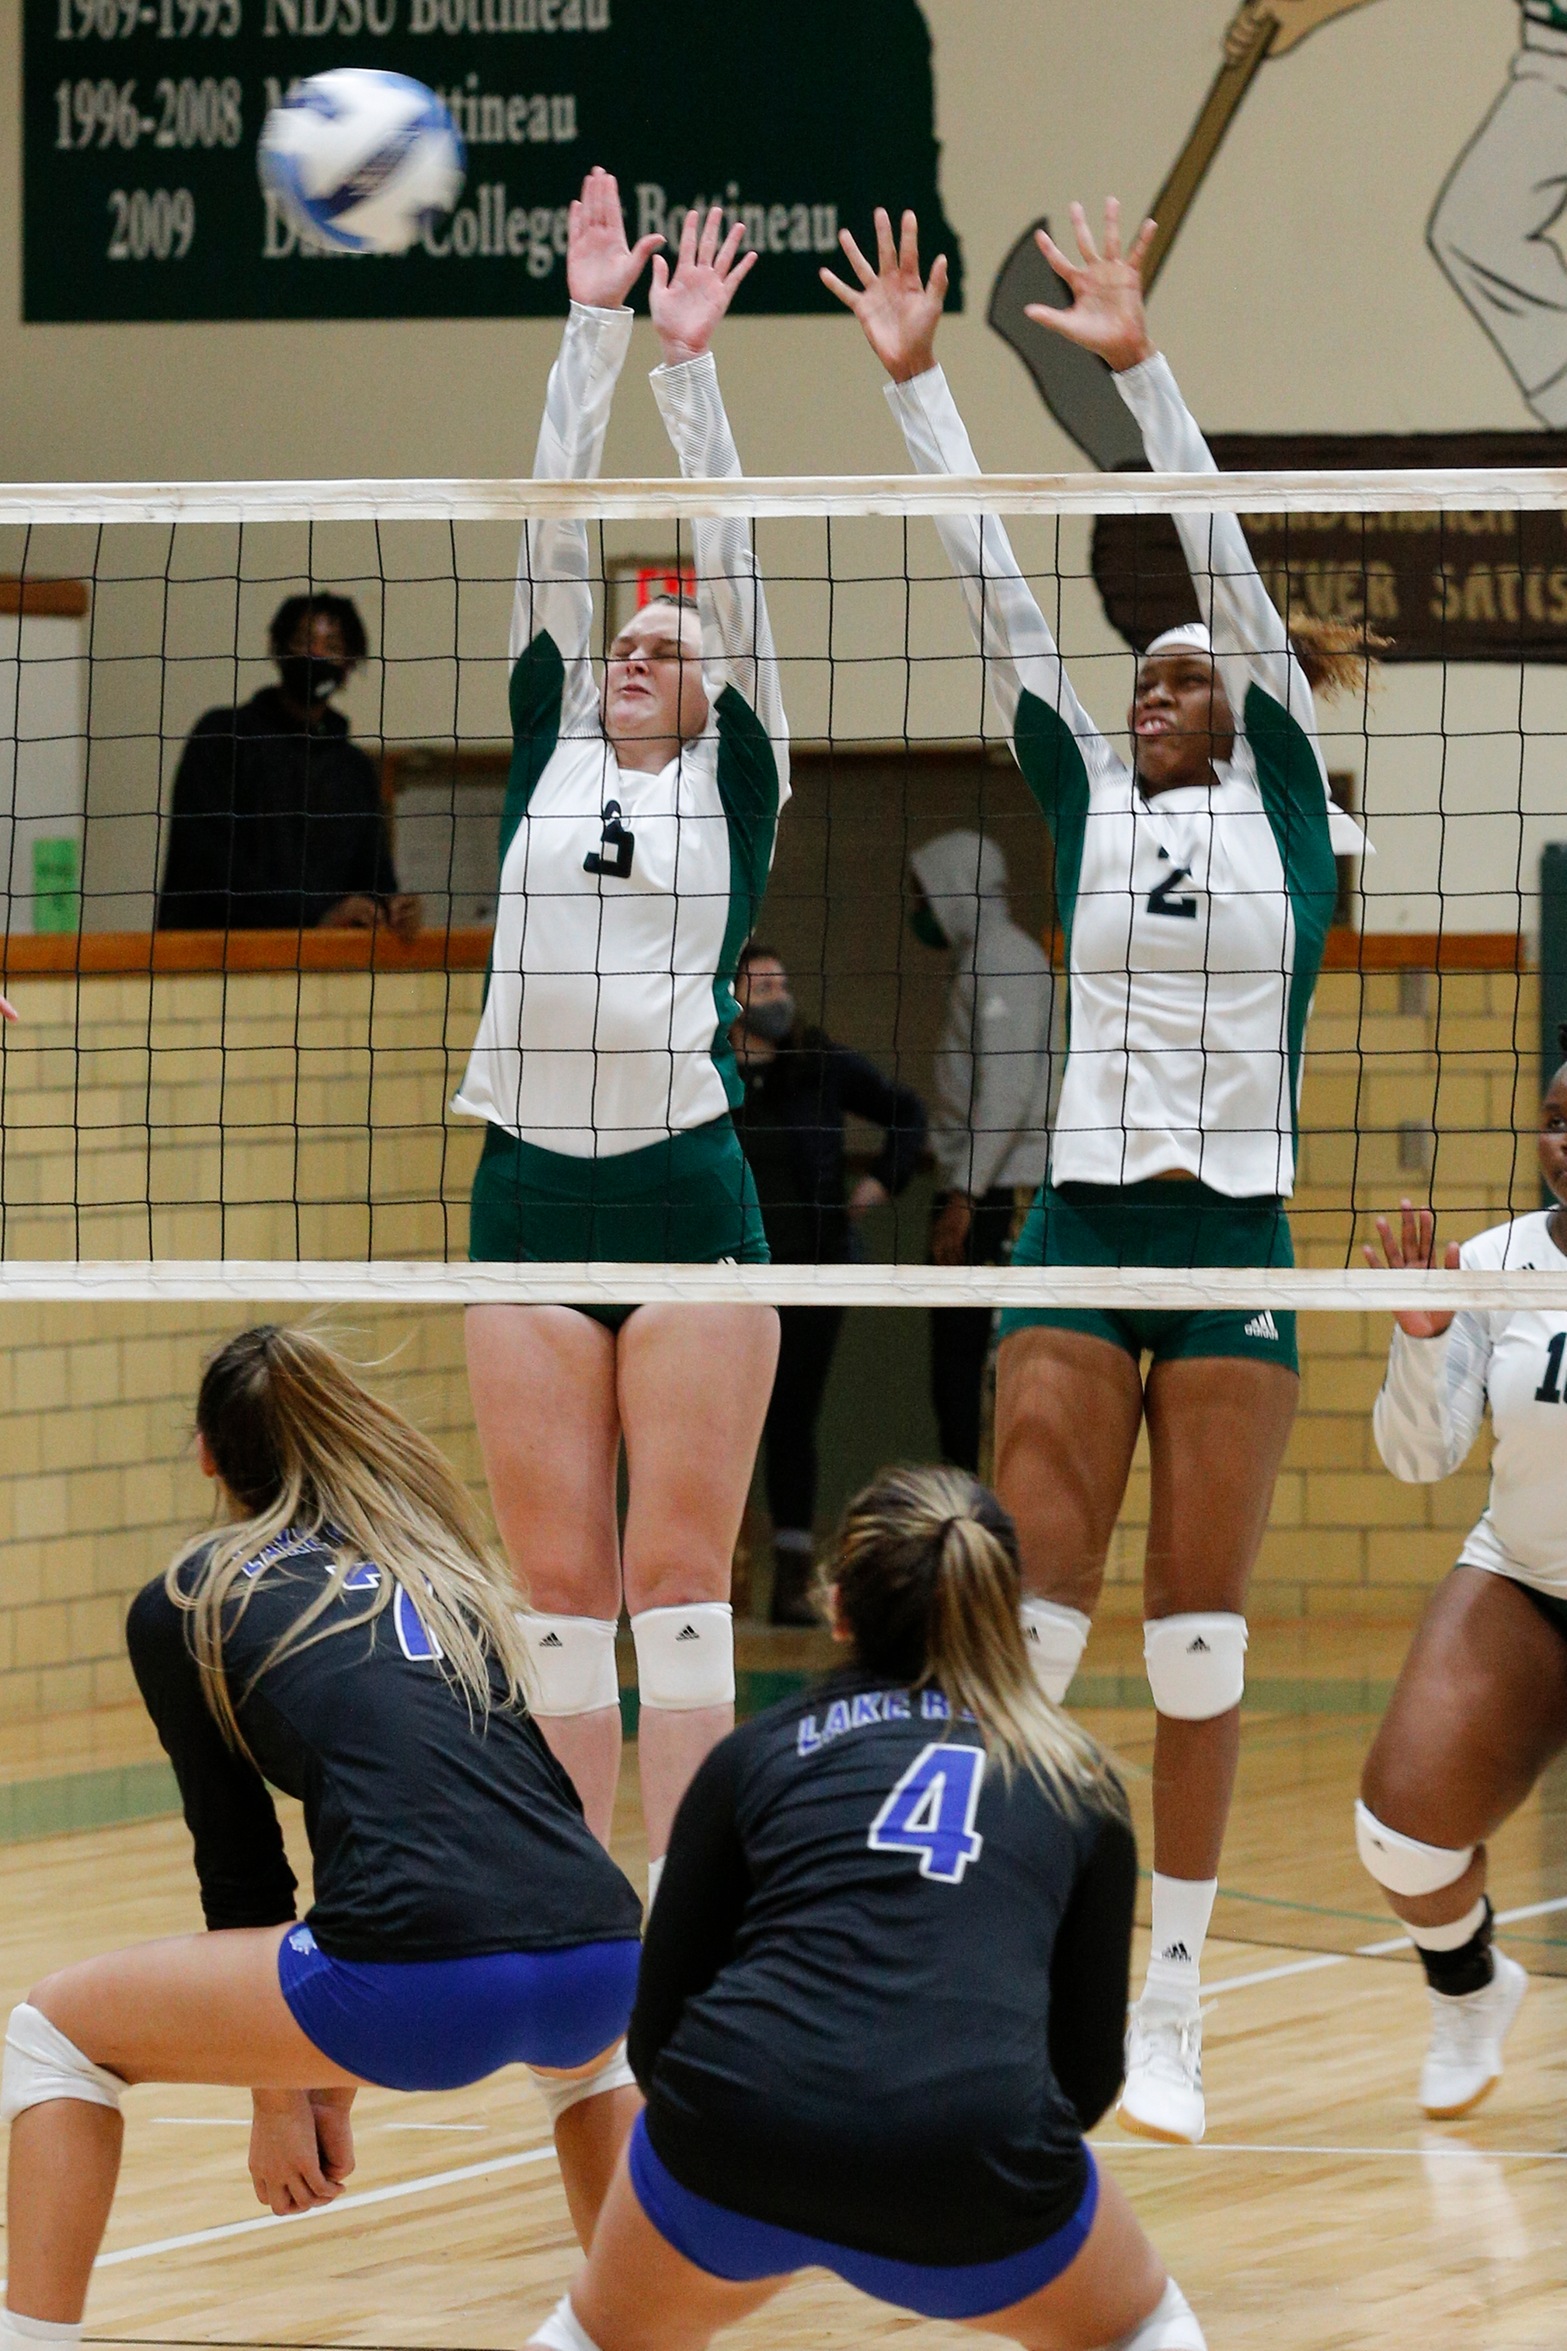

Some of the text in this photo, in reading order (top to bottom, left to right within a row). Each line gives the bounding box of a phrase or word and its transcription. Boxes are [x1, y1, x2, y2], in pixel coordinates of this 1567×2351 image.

[263, 0, 396, 37] NDSU
[55, 77, 242, 149] 1996-2008
[107, 187, 196, 260] 2009
[1145, 845, 1198, 920] 2
[1534, 1331, 1567, 1404] 1
[797, 1689, 911, 1757] LAKE
[867, 1742, 987, 1885] 4
